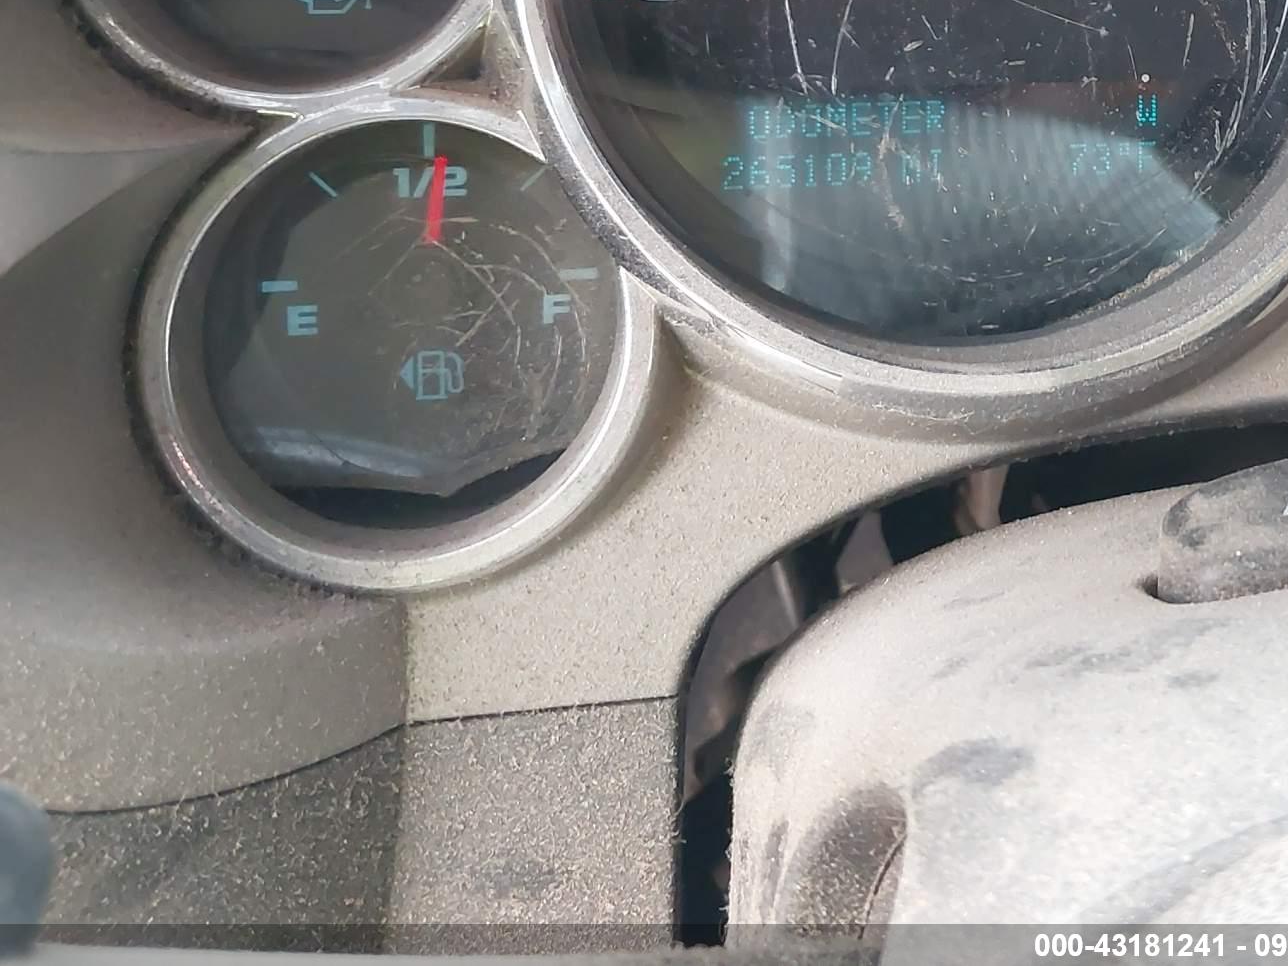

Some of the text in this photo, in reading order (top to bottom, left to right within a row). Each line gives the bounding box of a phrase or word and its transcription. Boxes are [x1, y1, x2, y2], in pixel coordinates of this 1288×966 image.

[749, 100, 945, 139] ODOMETER
[393, 166, 468, 199] 1/2
[287, 304, 318, 336] E
[542, 294, 571, 324] F
